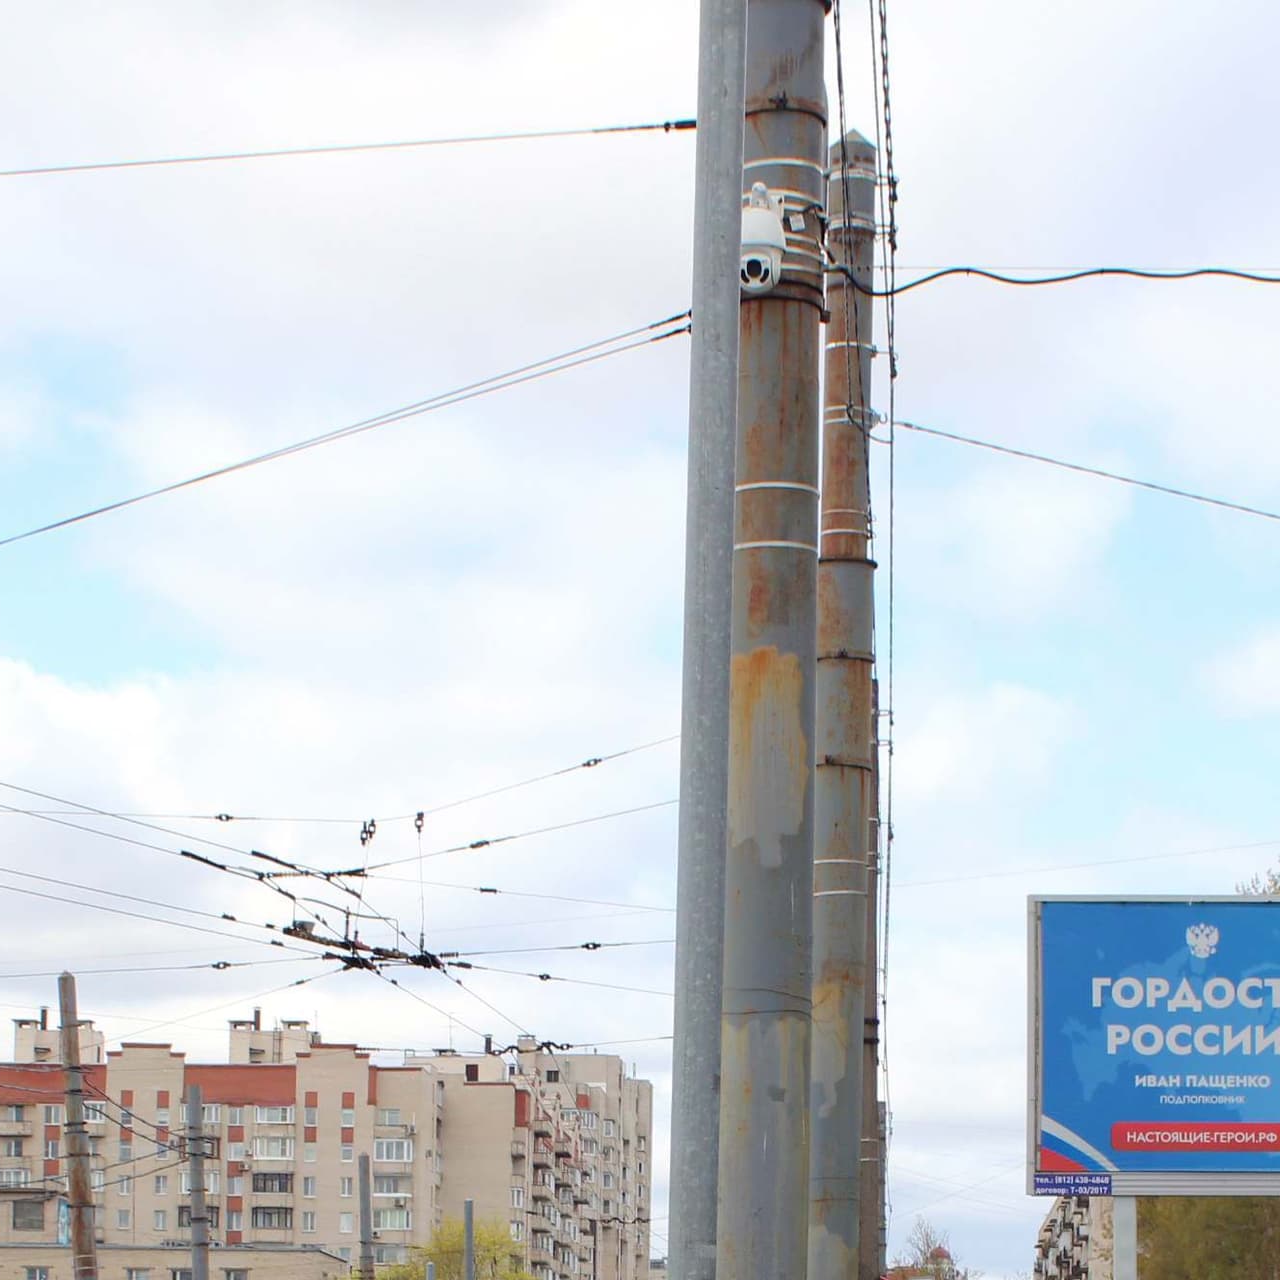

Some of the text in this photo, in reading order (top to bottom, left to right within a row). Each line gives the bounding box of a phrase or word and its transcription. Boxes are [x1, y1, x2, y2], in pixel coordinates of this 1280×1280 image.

[1135, 1075, 1270, 1089] ИВАН ПАЩЕНКО
[1160, 1095, 1245, 1104] ПОДПОЛКОВНИК
[1127, 1131, 1277, 1145] НАСТОЯЩИЕ-ГЕРОИ.РФ
